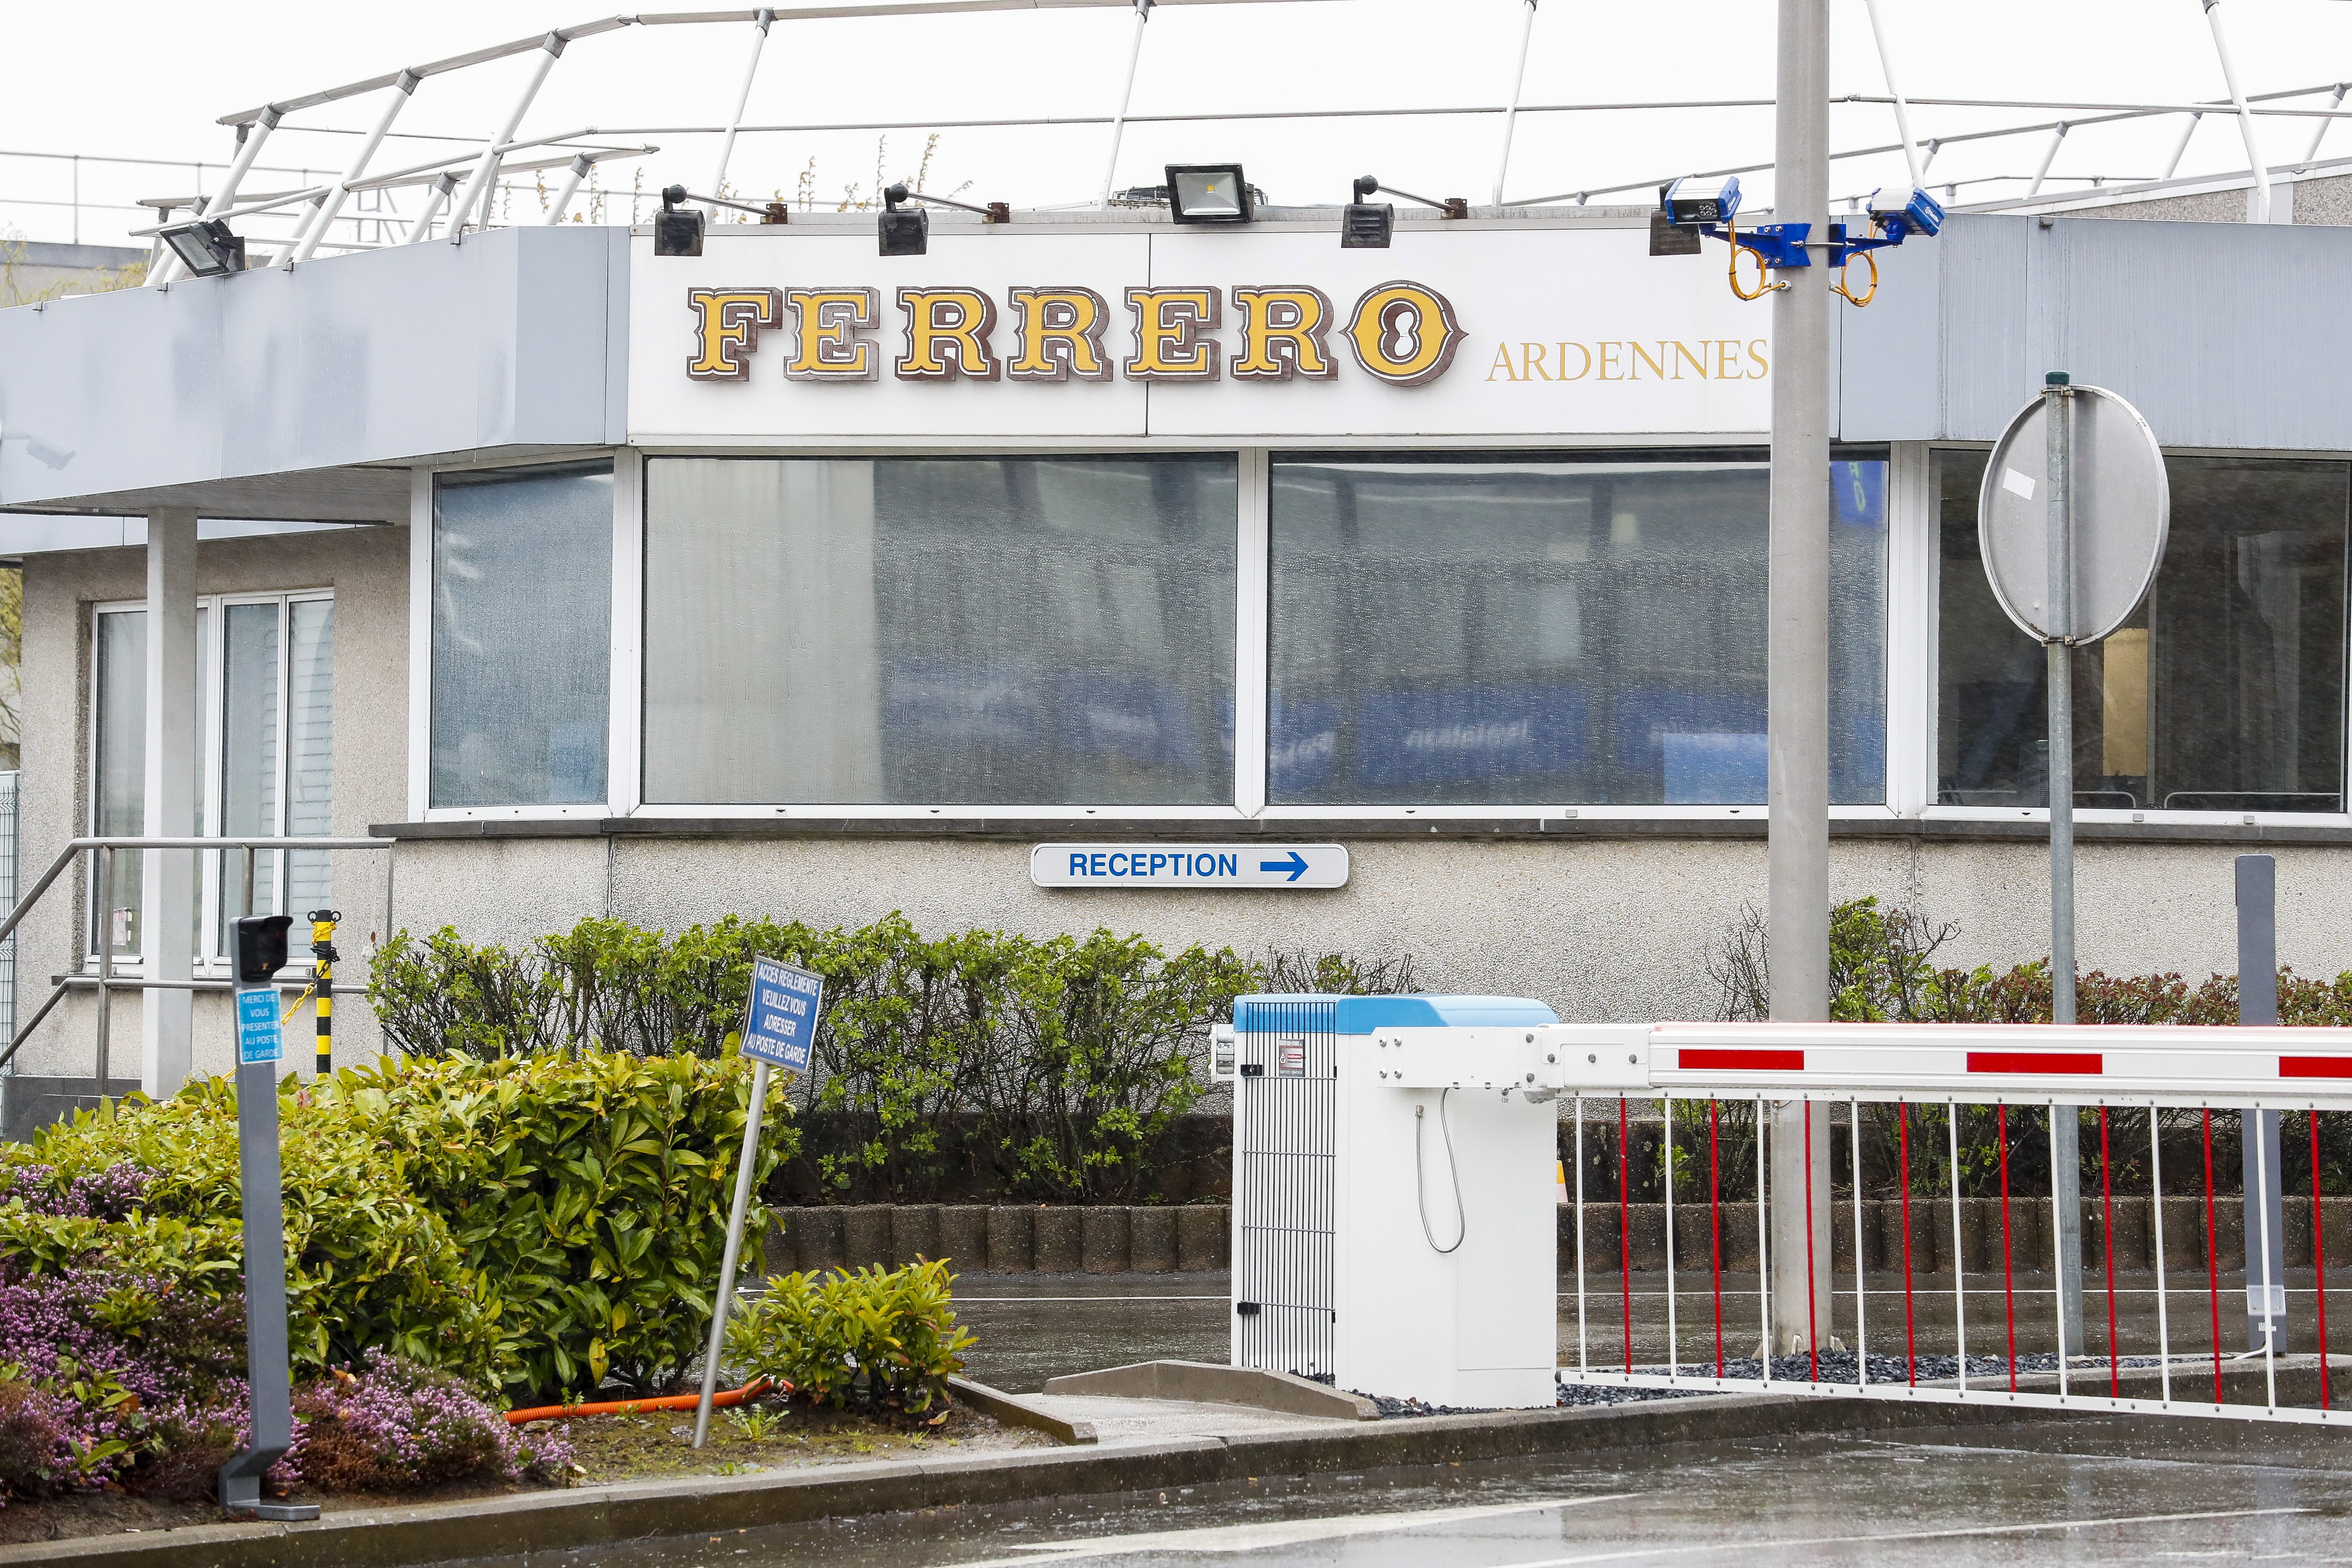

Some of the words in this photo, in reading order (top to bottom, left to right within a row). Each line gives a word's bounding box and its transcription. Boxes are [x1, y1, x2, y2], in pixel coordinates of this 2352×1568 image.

[686, 280, 1469, 386] FERRERO
[1484, 340, 1768, 382] ARDENNES
[1069, 853, 1237, 876] RECEPTION
[758, 963, 779, 984] ACCES
[779, 970, 818, 996] REGLEMENTE
[243, 995, 264, 1004] MERCI
[265, 994, 275, 1003] DE
[762, 988, 790, 1011] VEUILLEZ
[790, 997, 807, 1016] VOUS
[249, 1008, 270, 1018] VOUS
[241, 1021, 279, 1032] PRESENTER
[763, 1014, 796, 1037] ADRESSER
[256, 1035, 278, 1044] POSTE
[747, 1033, 756, 1049] AU
[755, 1035, 776, 1055] POSTE
[775, 1041, 786, 1058] DE
[785, 1043, 806, 1064] GARDE
[244, 1051, 253, 1059] DE
[255, 1048, 278, 1059] GARDE
